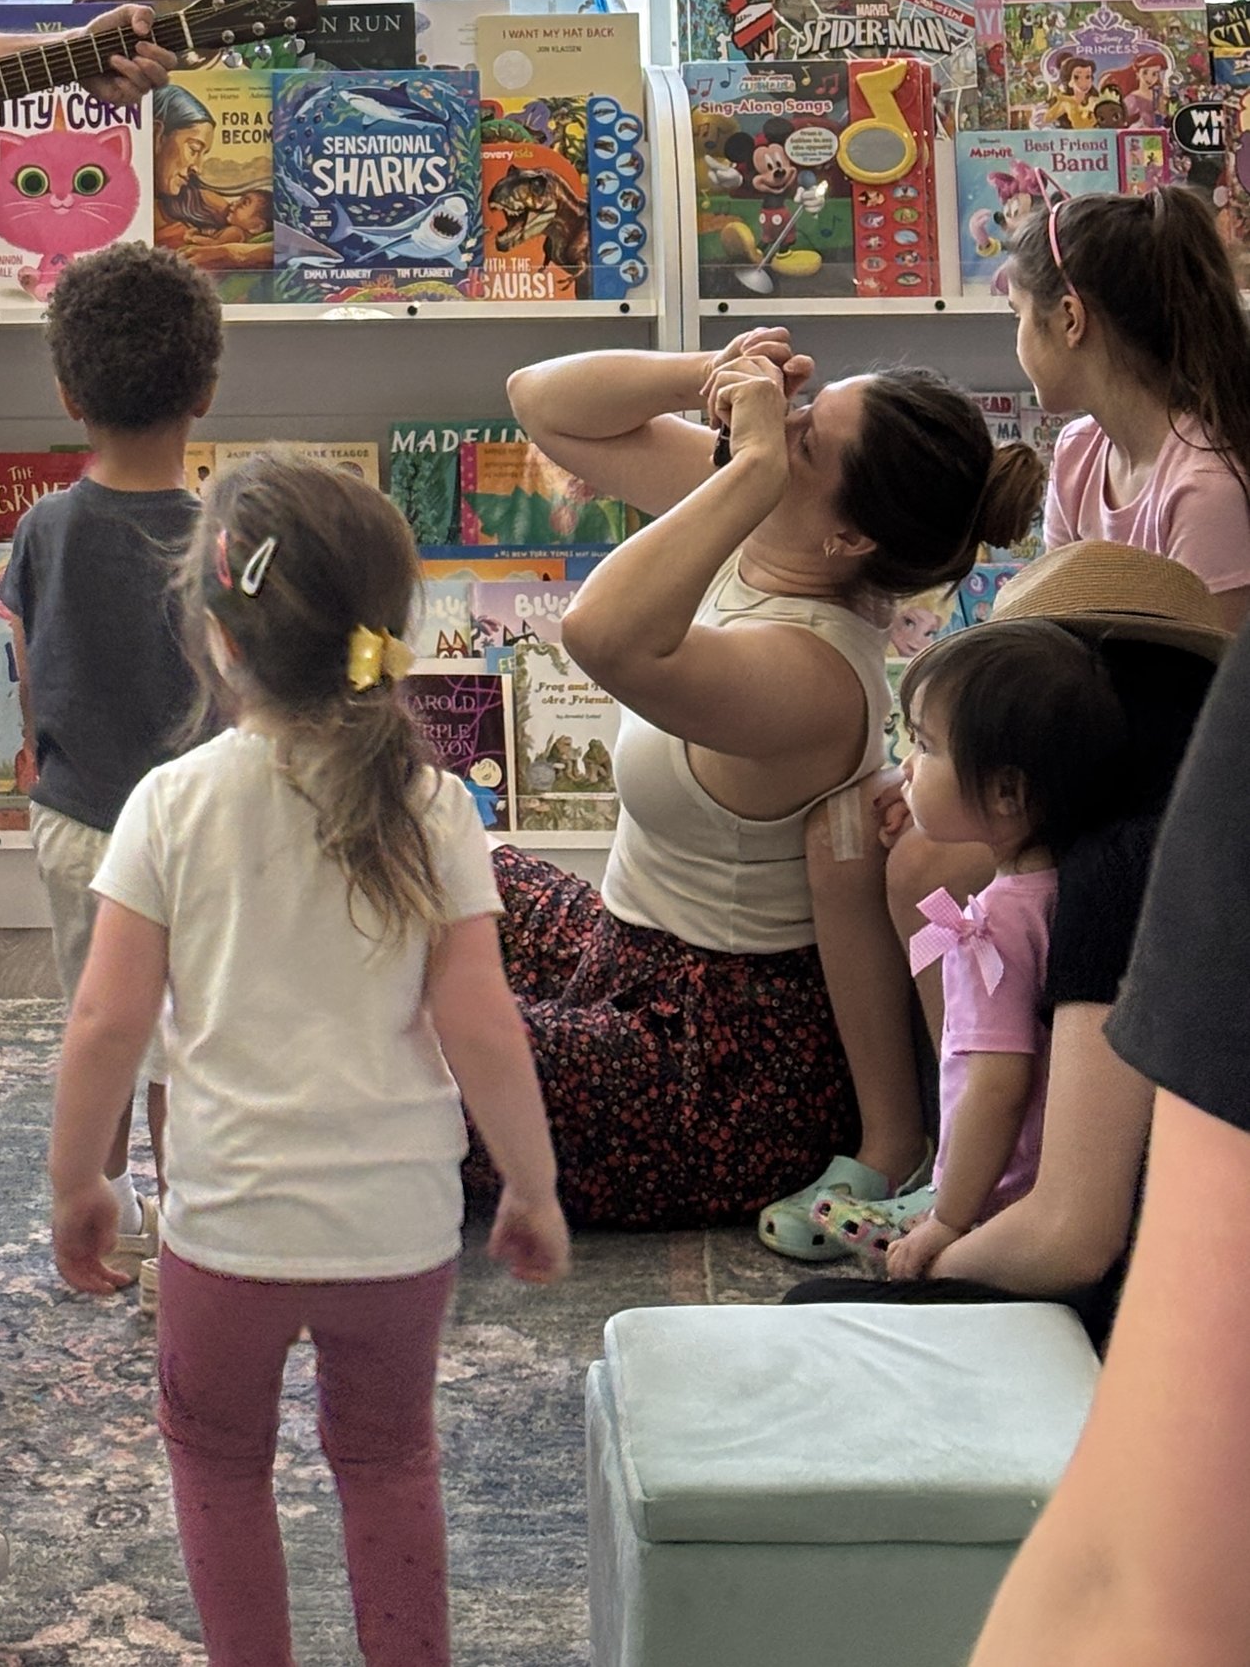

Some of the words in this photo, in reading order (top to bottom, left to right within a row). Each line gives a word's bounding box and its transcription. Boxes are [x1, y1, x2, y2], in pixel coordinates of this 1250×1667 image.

[856, 3, 889, 17] MARVEL
[1227, 5, 1247, 23] MY
[348, 14, 402, 32] RUN
[508, 28, 539, 39] WANT
[543, 28, 560, 38] MY
[562, 28, 584, 38] HAT
[586, 27, 615, 38] BACK
[800, 18, 951, 55] SPIDER-MAN
[1076, 44, 1139, 55] PRINCESS
[700, 100, 783, 115] Sing-Along
[786, 98, 833, 114] Songs
[222, 111, 250, 125] FOR
[254, 111, 263, 125] A
[222, 128, 274, 145] BECOM
[322, 135, 436, 155] SENSATIONAL
[1023, 138, 1054, 153] Best
[1059, 138, 1109, 152] Friend
[1051, 153, 1109, 172] Band
[312, 156, 448, 198] SHARKS
[511, 257, 531, 272] THE
[304, 269, 328, 280] EMMA
[482, 272, 555, 299] SAURS!
[8, 465, 35, 482] THE
[515, 592, 575, 622] BLUE
[535, 682, 565, 693] Frog
[567, 682, 589, 691] and
[406, 695, 476, 711] AROLD
[541, 695, 566, 704] Are
[568, 694, 614, 706] Friends
[423, 723, 471, 740] RPLE
[436, 739, 475, 756] YON
